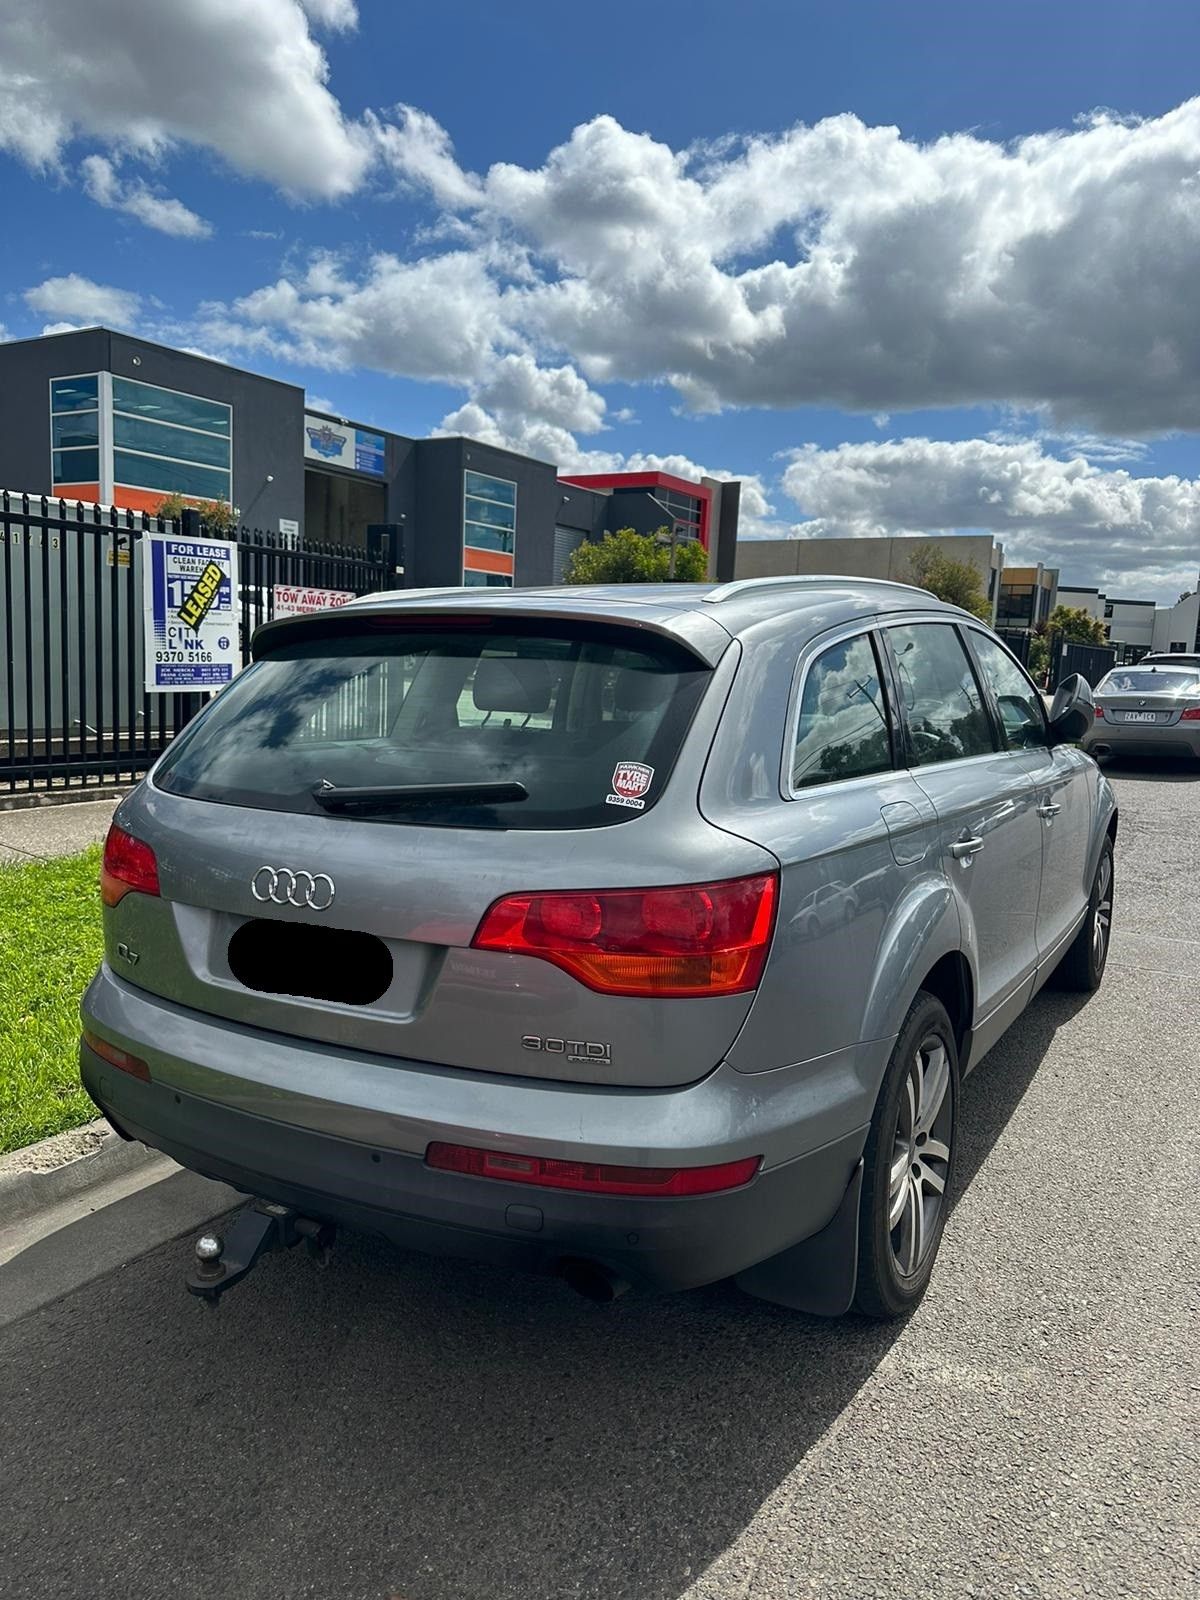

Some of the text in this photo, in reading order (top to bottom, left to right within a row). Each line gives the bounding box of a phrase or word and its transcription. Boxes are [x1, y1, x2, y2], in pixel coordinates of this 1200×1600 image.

[171, 544, 227, 558] FOR LEASE
[173, 557, 196, 565] CLEAN
[180, 564, 222, 626] LEASED
[276, 591, 299, 604] TOW
[302, 595, 327, 606] AWAY
[155, 651, 212, 662] 9370 5166
[617, 770, 649, 784] TYRE
[616, 780, 646, 791] MART
[625, 799, 643, 807] 0004
[117, 942, 140, 966] Q7
